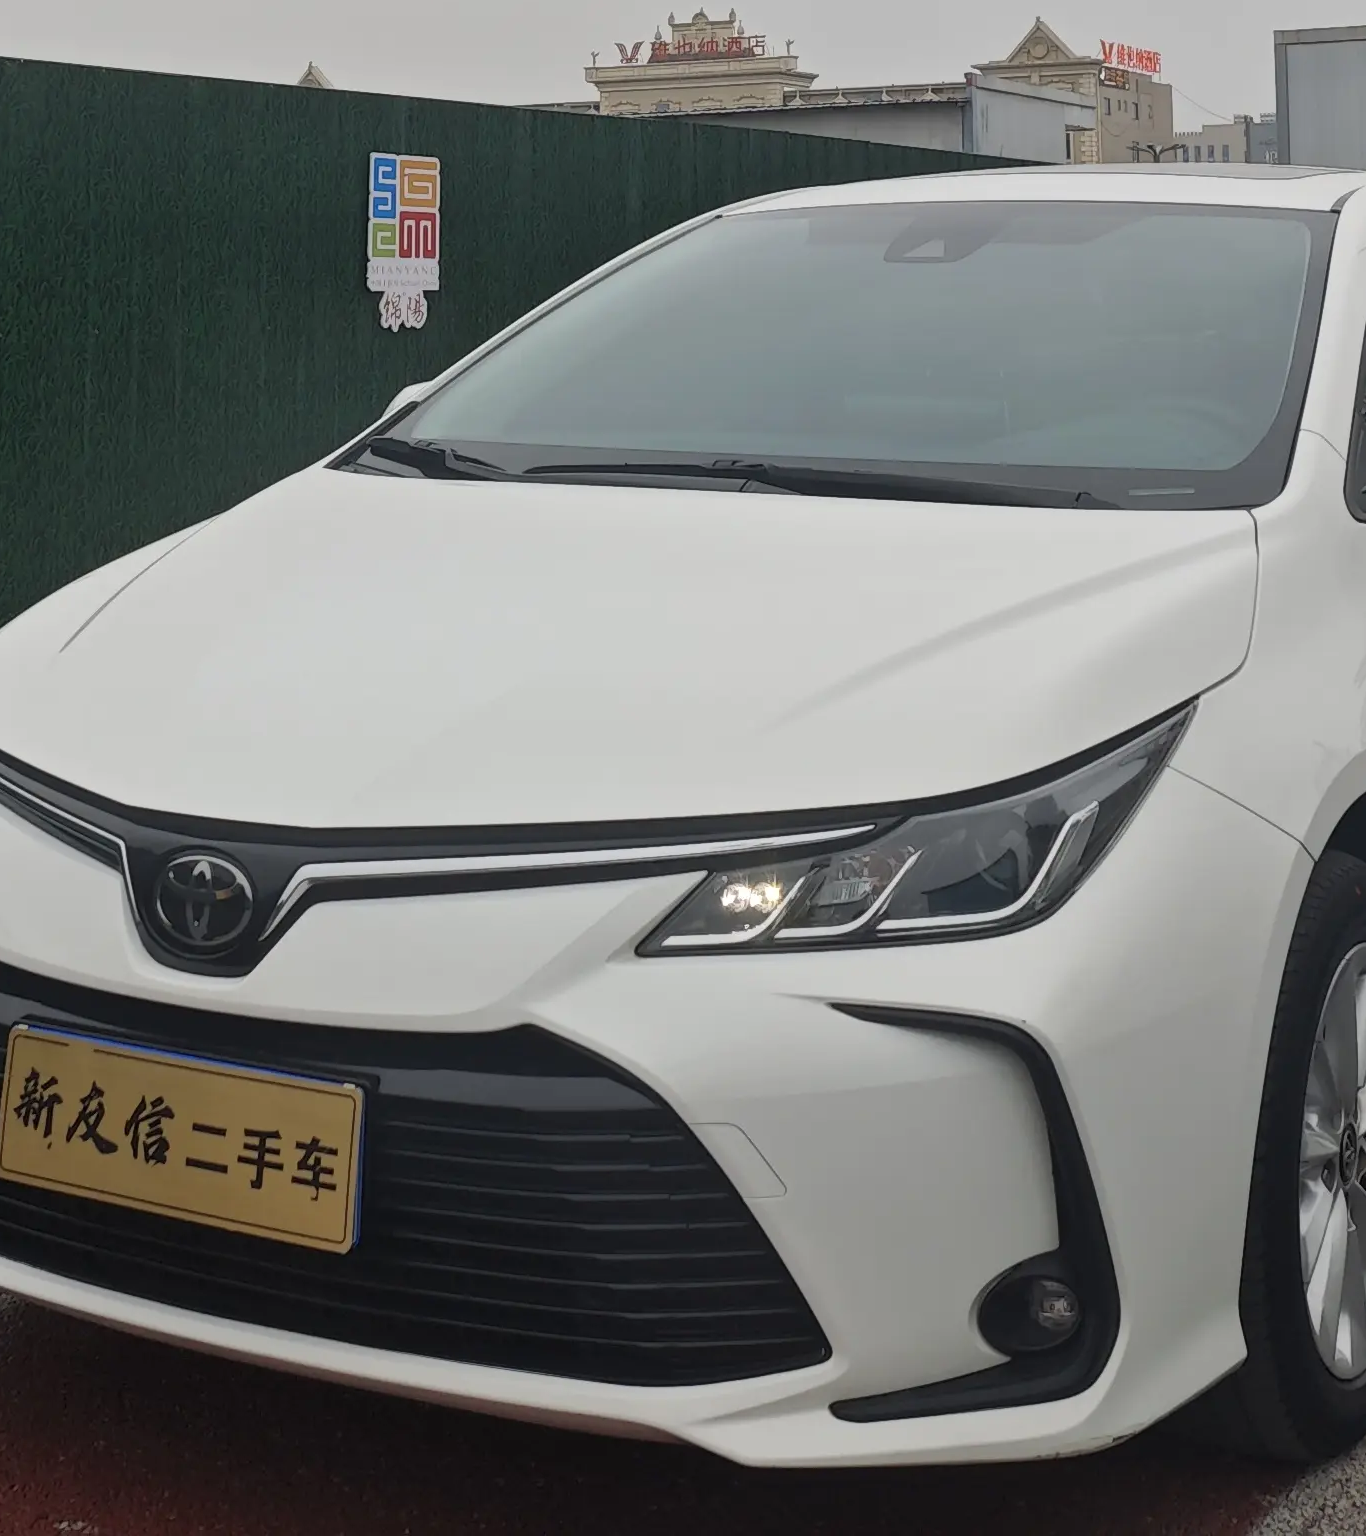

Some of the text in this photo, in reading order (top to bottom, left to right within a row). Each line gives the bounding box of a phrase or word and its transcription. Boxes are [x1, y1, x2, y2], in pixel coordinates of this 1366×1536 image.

[650, 35, 766, 57] 维也纳酒店
[13, 1066, 339, 1202] 新友信二手车
